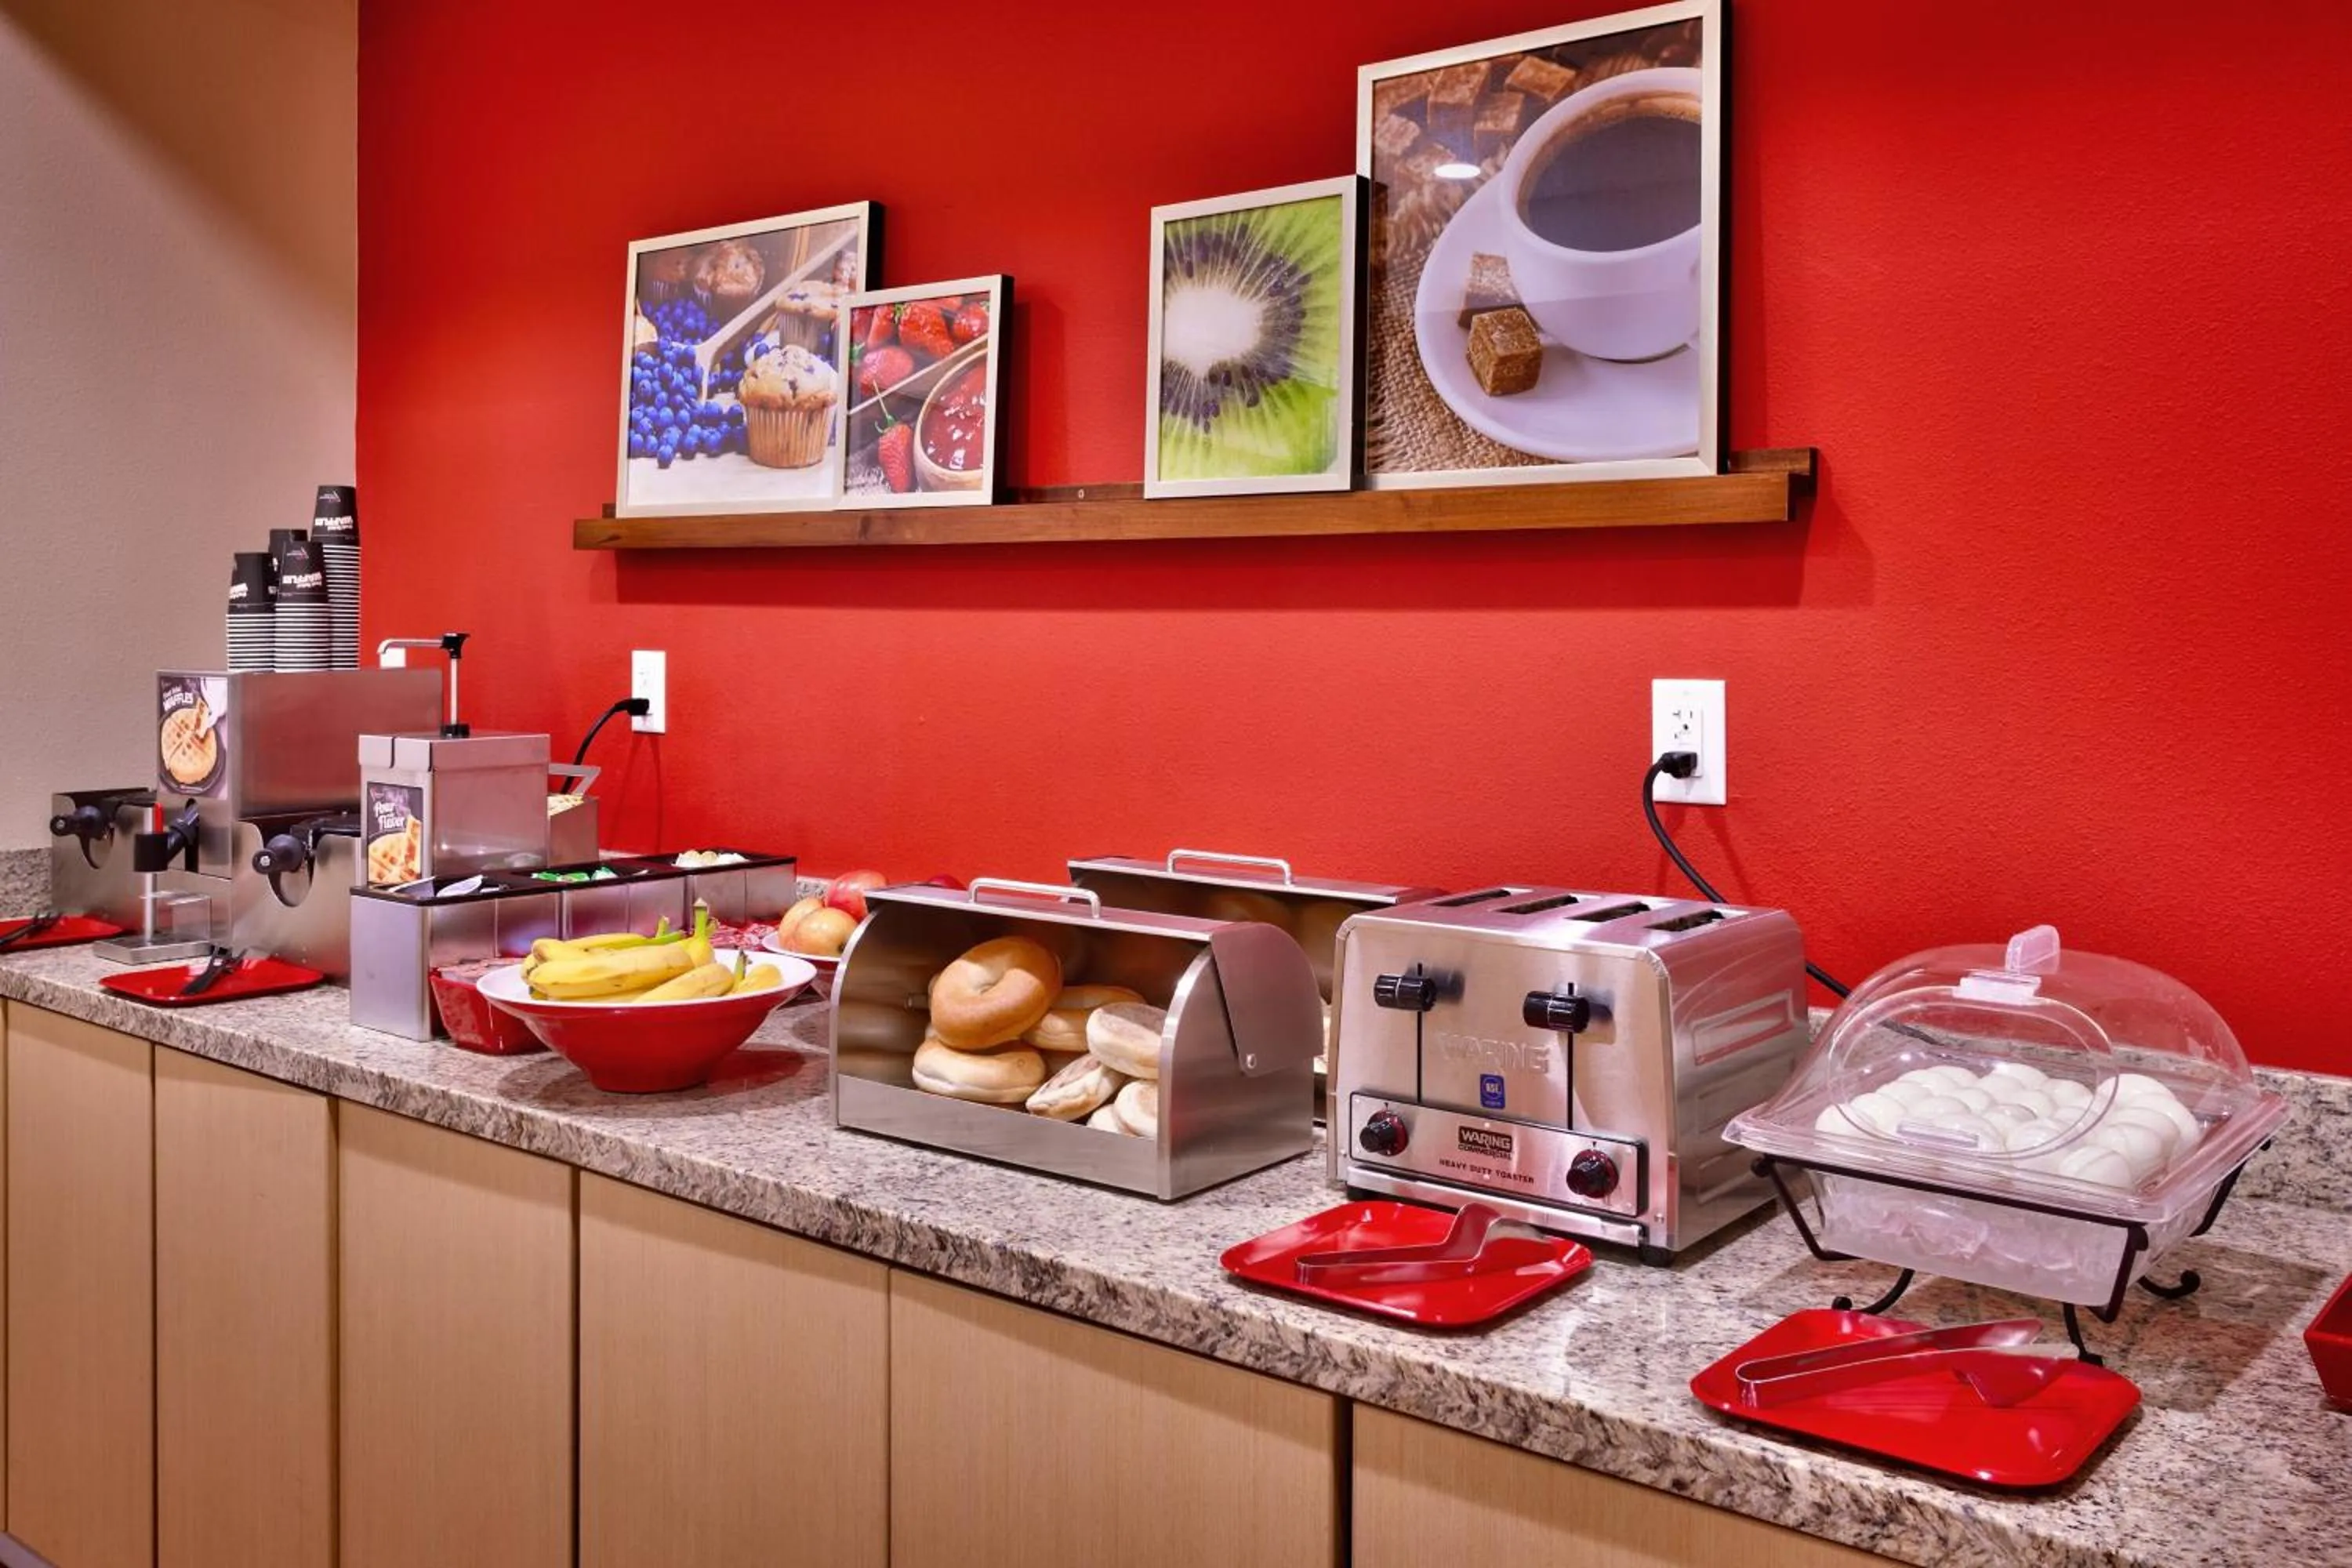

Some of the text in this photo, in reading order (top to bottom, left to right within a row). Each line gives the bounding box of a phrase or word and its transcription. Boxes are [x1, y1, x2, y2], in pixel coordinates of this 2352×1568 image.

[1437, 1032, 1550, 1074] WARING
[1461, 1129, 1511, 1149] WARING
[1458, 1144, 1512, 1161] COMMERCIAL
[1439, 1159, 1534, 1184] HEAVY DUTY TOASTER
